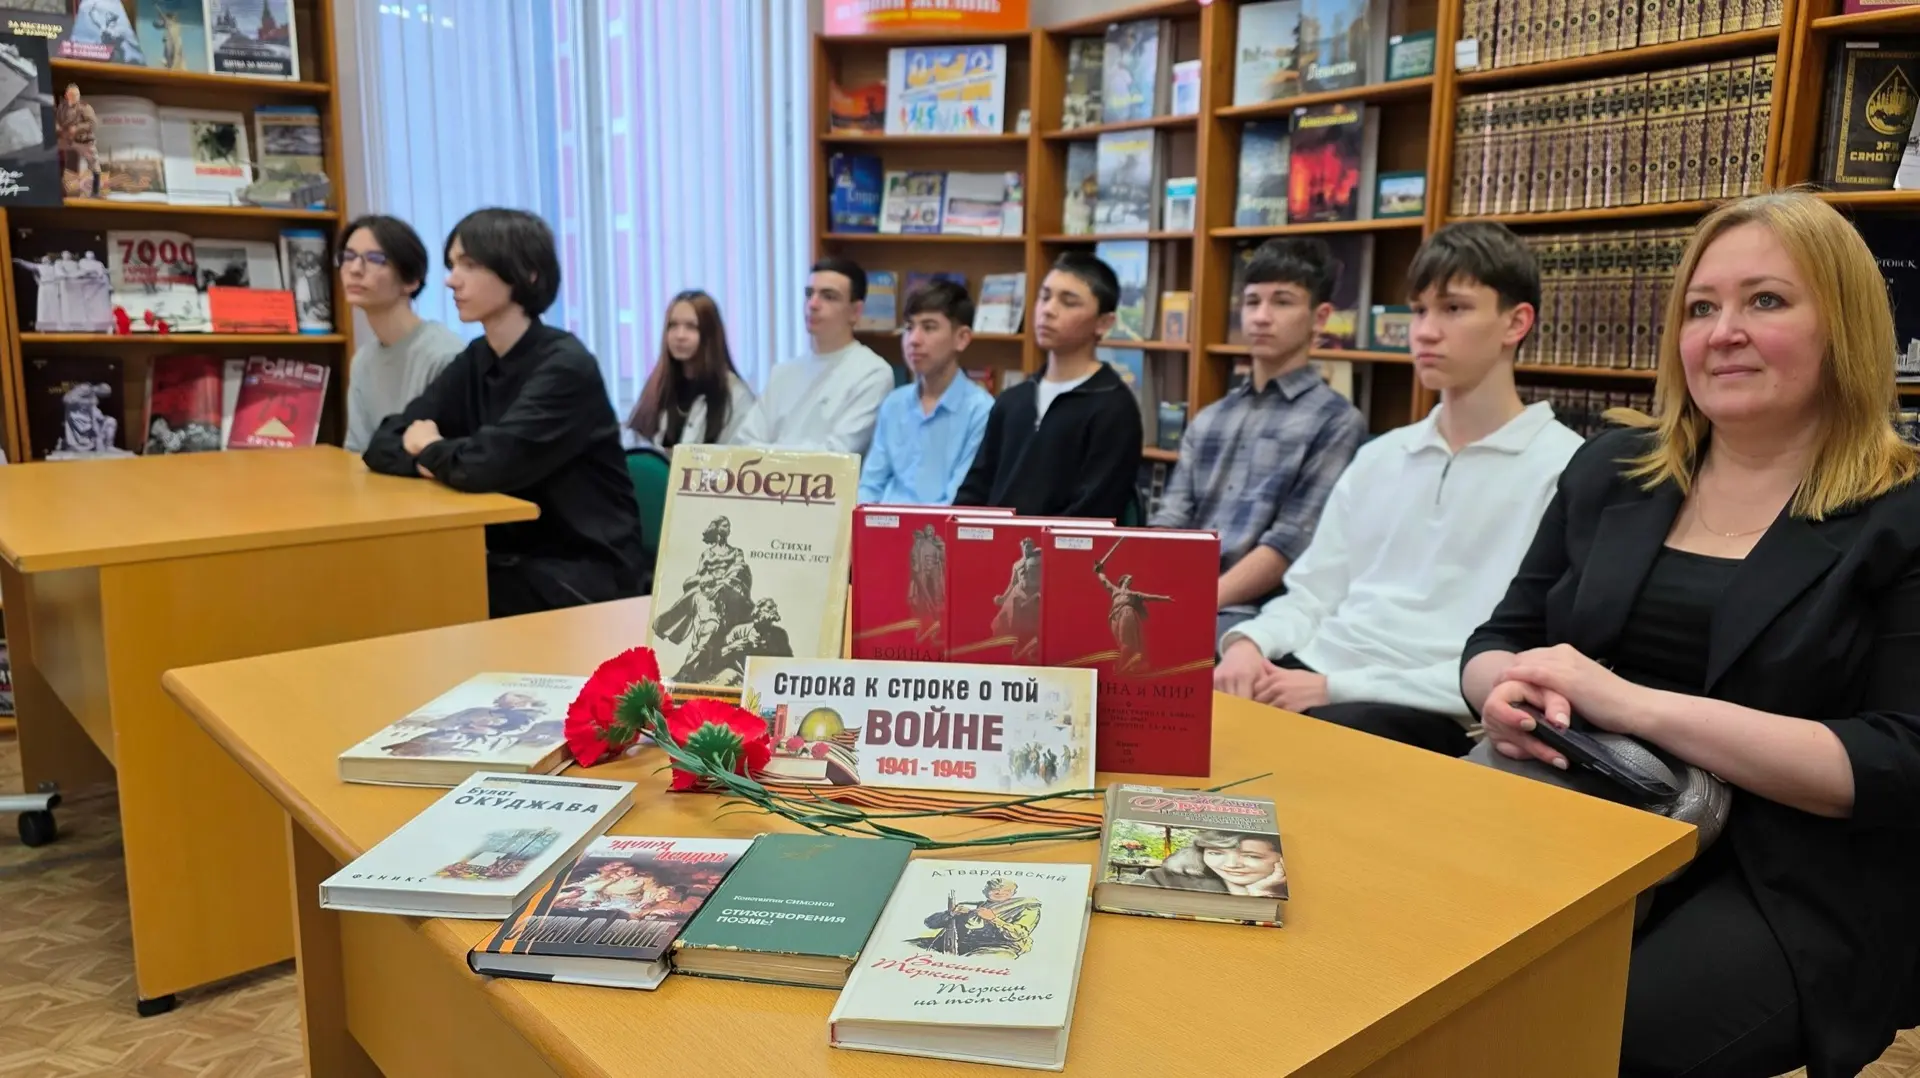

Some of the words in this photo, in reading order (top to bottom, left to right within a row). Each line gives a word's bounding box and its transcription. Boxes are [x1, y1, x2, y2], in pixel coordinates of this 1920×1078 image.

[116, 239, 195, 266] 7000
[1877, 258, 1918, 269] РТОВСК
[770, 538, 813, 552] Стихи
[750, 550, 807, 563] военных
[808, 554, 832, 563] лет
[865, 676, 879, 697] к
[979, 681, 992, 701] о
[1153, 684, 1194, 699] МИР
[864, 705, 1004, 753] ВОЙНЕ
[467, 785, 517, 799] Булат
[455, 795, 600, 815] ОКУДЖАВА
[716, 916, 775, 926] ПОЭМЫ
[721, 908, 847, 924] СТИХОТВОРЕНИЯ
[905, 952, 1012, 976] Василий
[936, 983, 1026, 997] Теркин
[945, 997, 994, 1005] том
[999, 991, 1055, 1003] свете
